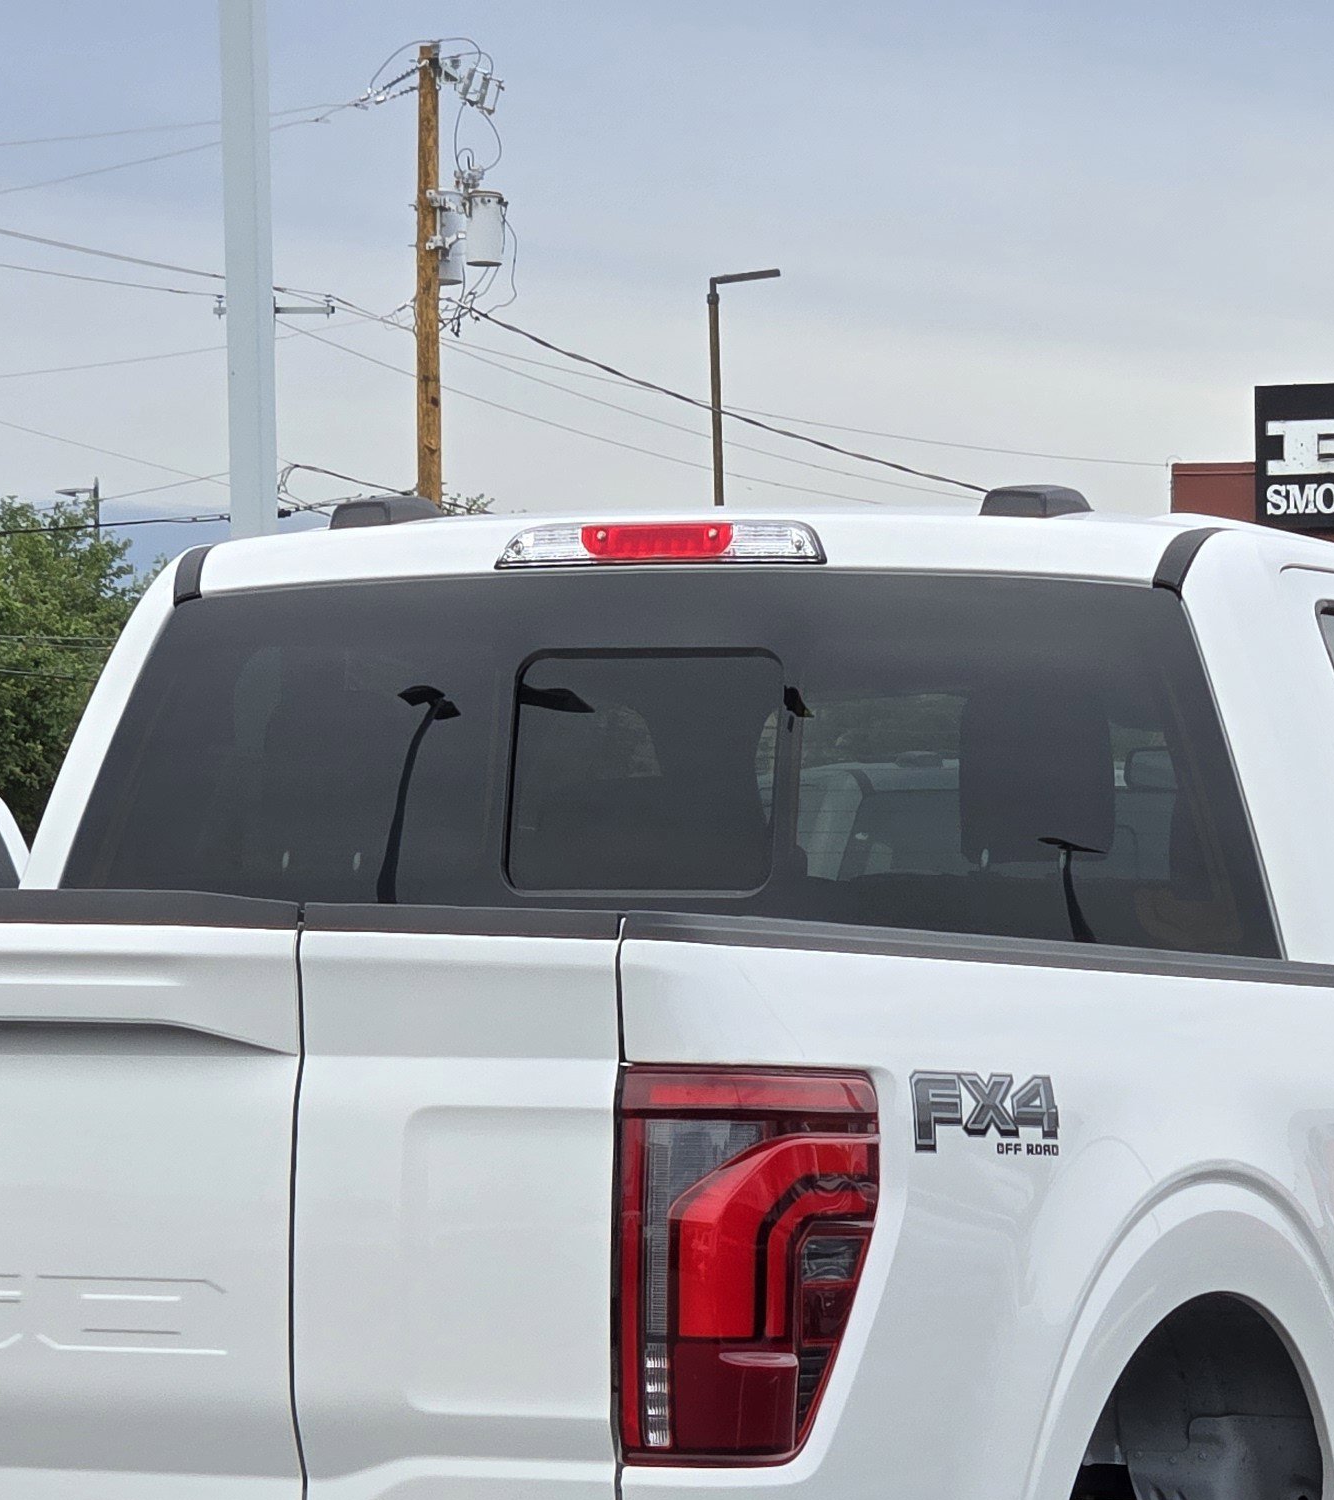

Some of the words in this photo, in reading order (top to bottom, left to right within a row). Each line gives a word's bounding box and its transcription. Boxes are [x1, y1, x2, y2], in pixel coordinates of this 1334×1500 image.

[909, 1070, 1059, 1153] FX4
[996, 1143, 1022, 1155] OFF
[1026, 1144, 1059, 1156] ROAD
